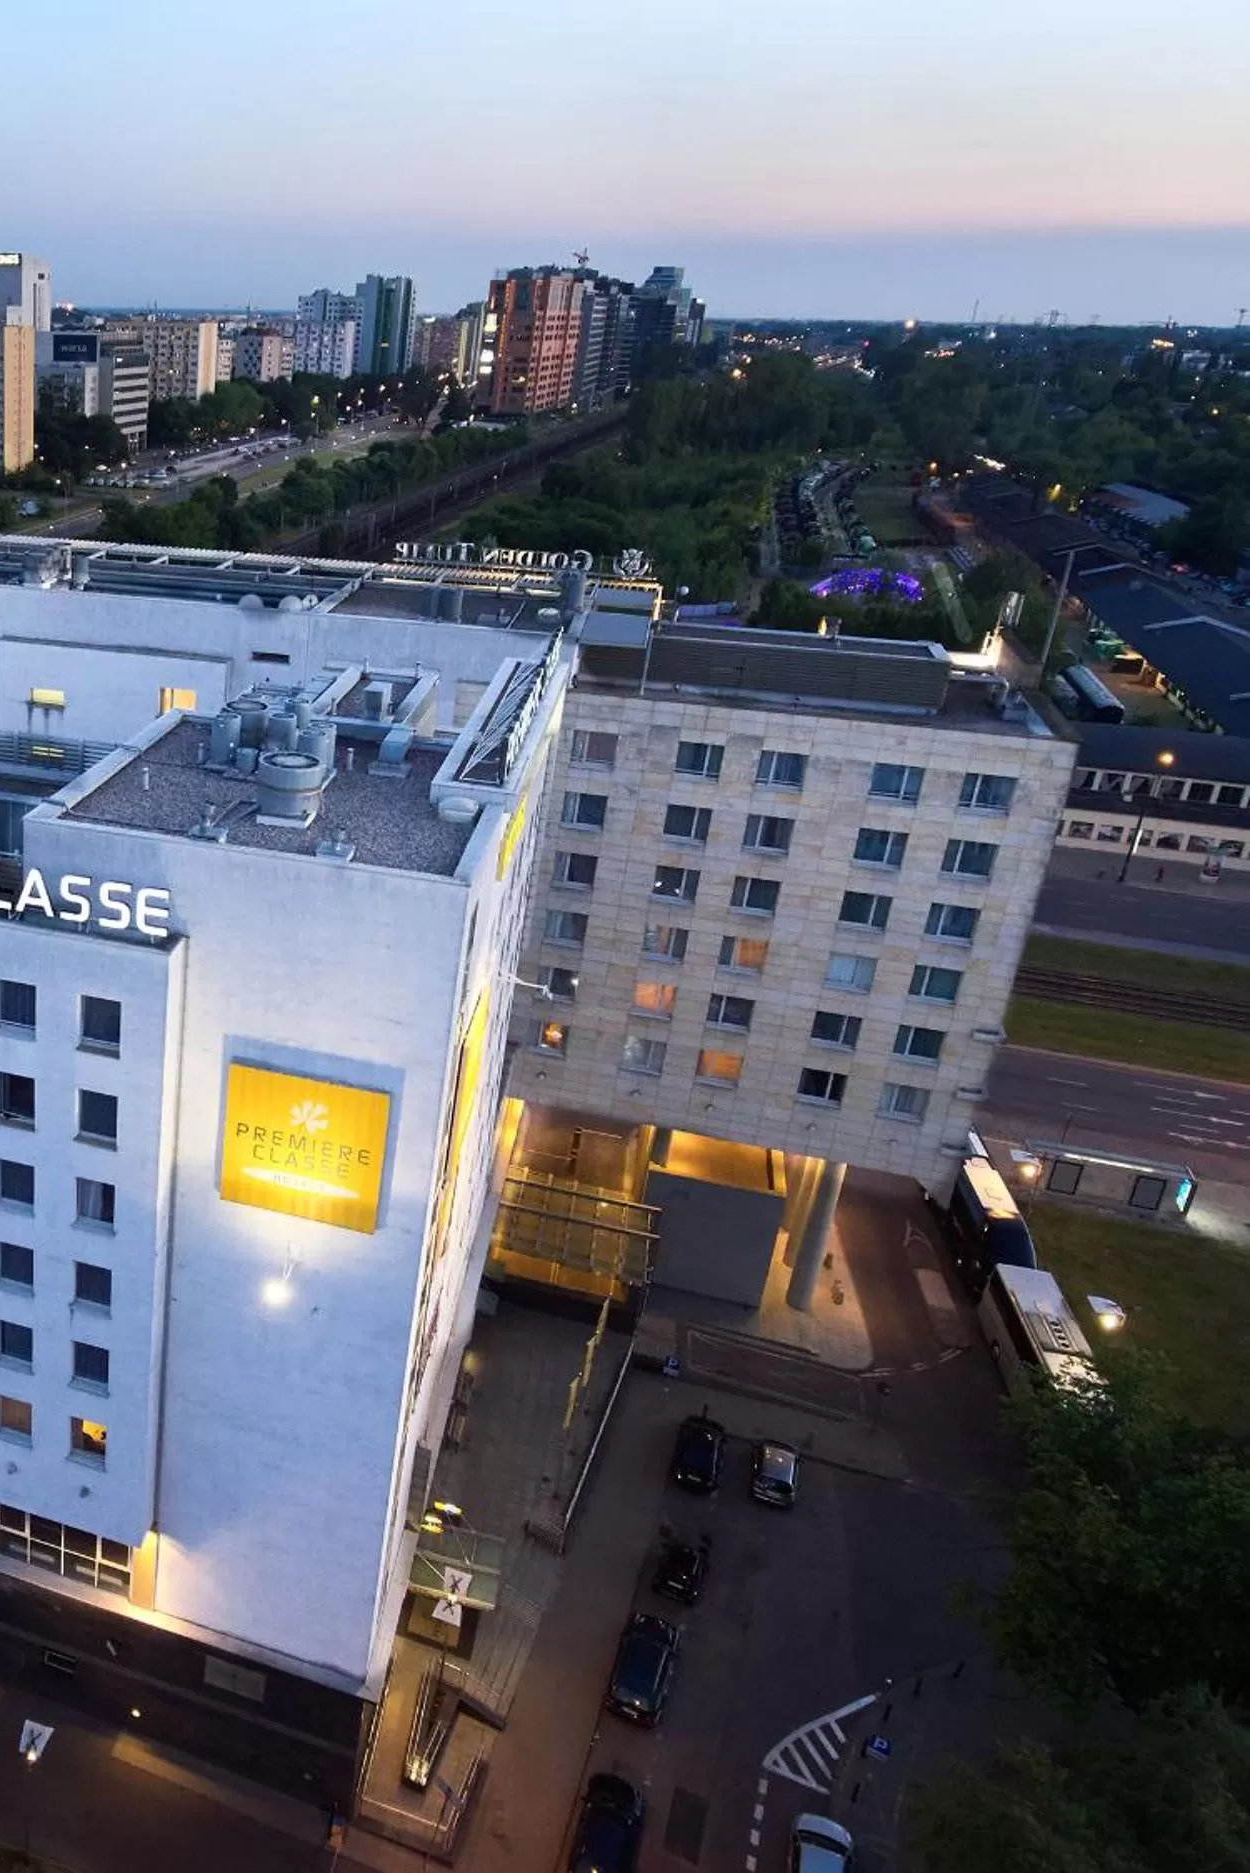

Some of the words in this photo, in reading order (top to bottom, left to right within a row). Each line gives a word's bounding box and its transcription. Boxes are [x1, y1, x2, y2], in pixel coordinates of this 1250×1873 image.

[236, 1122, 371, 1166] PREMIERE
[252, 1144, 350, 1179] CLASSE
[873, 1736, 888, 1749] P
